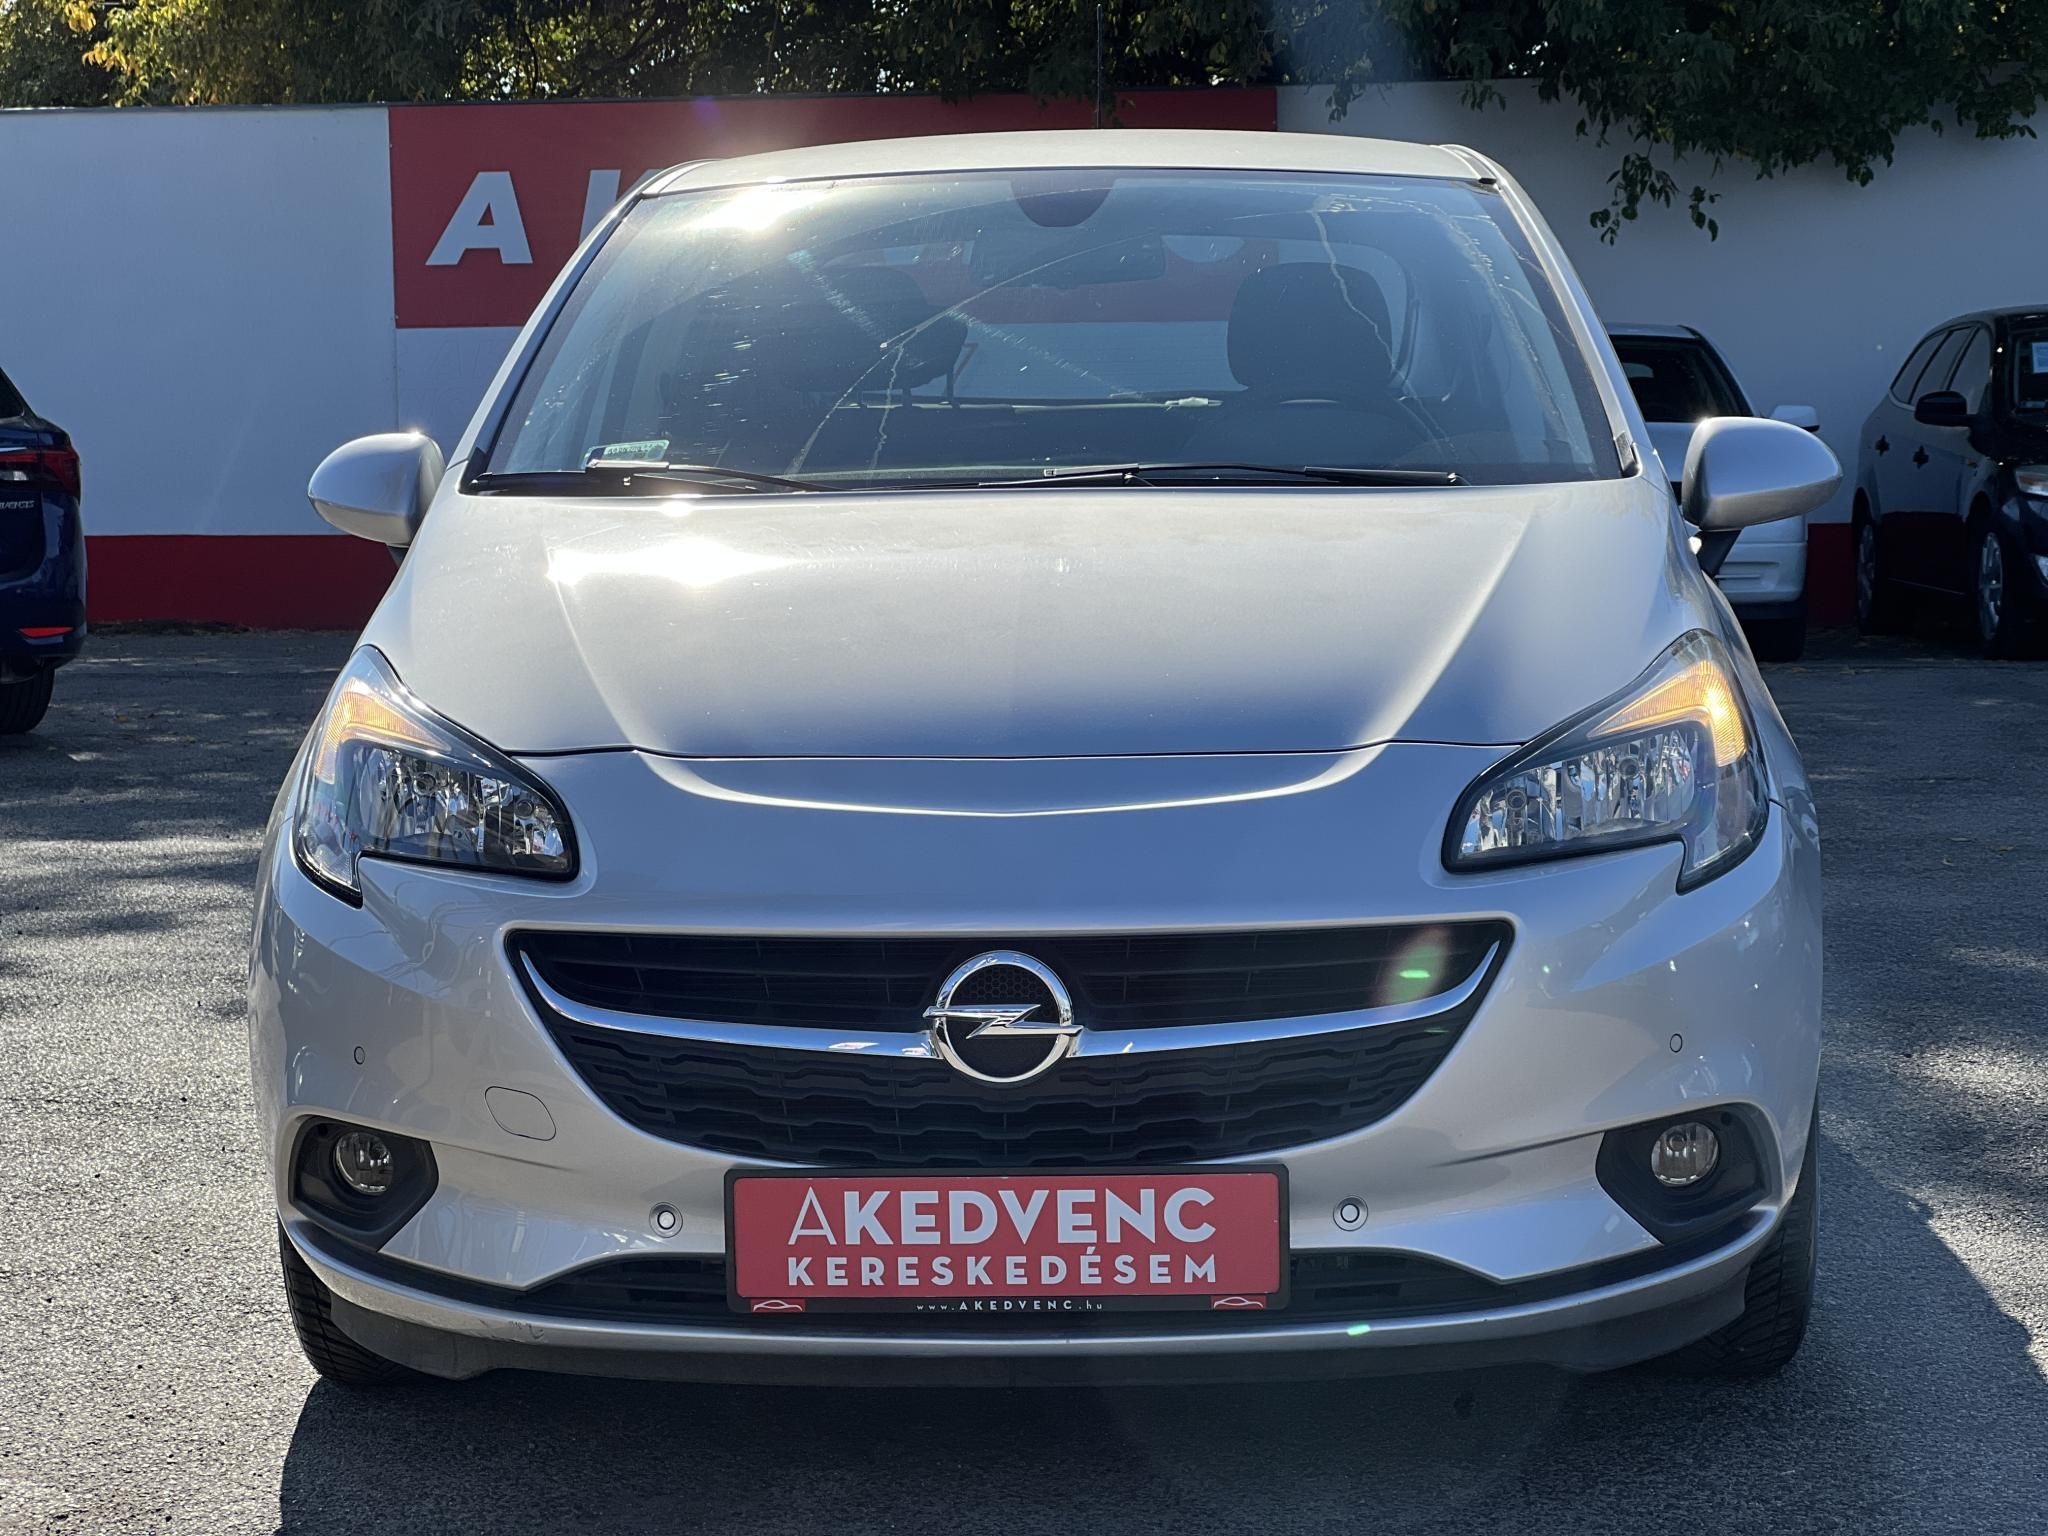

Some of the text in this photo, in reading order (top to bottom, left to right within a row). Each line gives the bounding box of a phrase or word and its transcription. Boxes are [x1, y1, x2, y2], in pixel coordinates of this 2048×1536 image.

[788, 1186, 1216, 1245] AKEDVENC
[788, 1246, 1216, 1286] KERESKEDÉSEM
[916, 1300, 1102, 1311] www.AKEDVENC.hu
